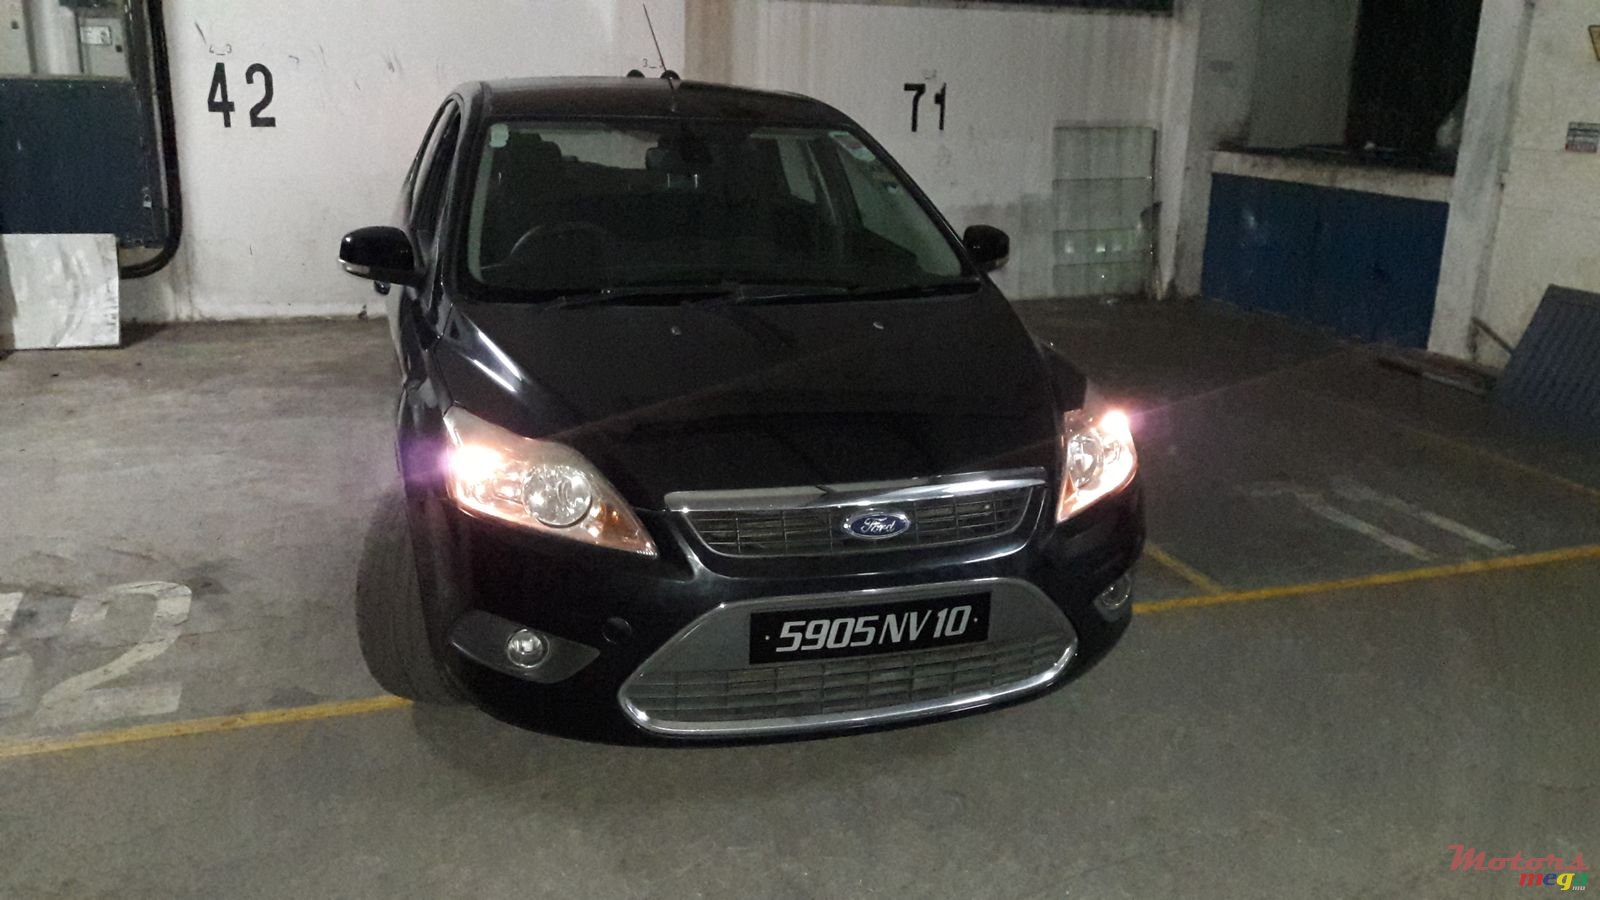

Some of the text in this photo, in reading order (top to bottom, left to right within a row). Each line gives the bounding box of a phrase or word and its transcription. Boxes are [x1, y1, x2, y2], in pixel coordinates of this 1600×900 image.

[207, 62, 276, 128] 42
[904, 82, 947, 132] 71
[860, 517, 896, 533] Ford
